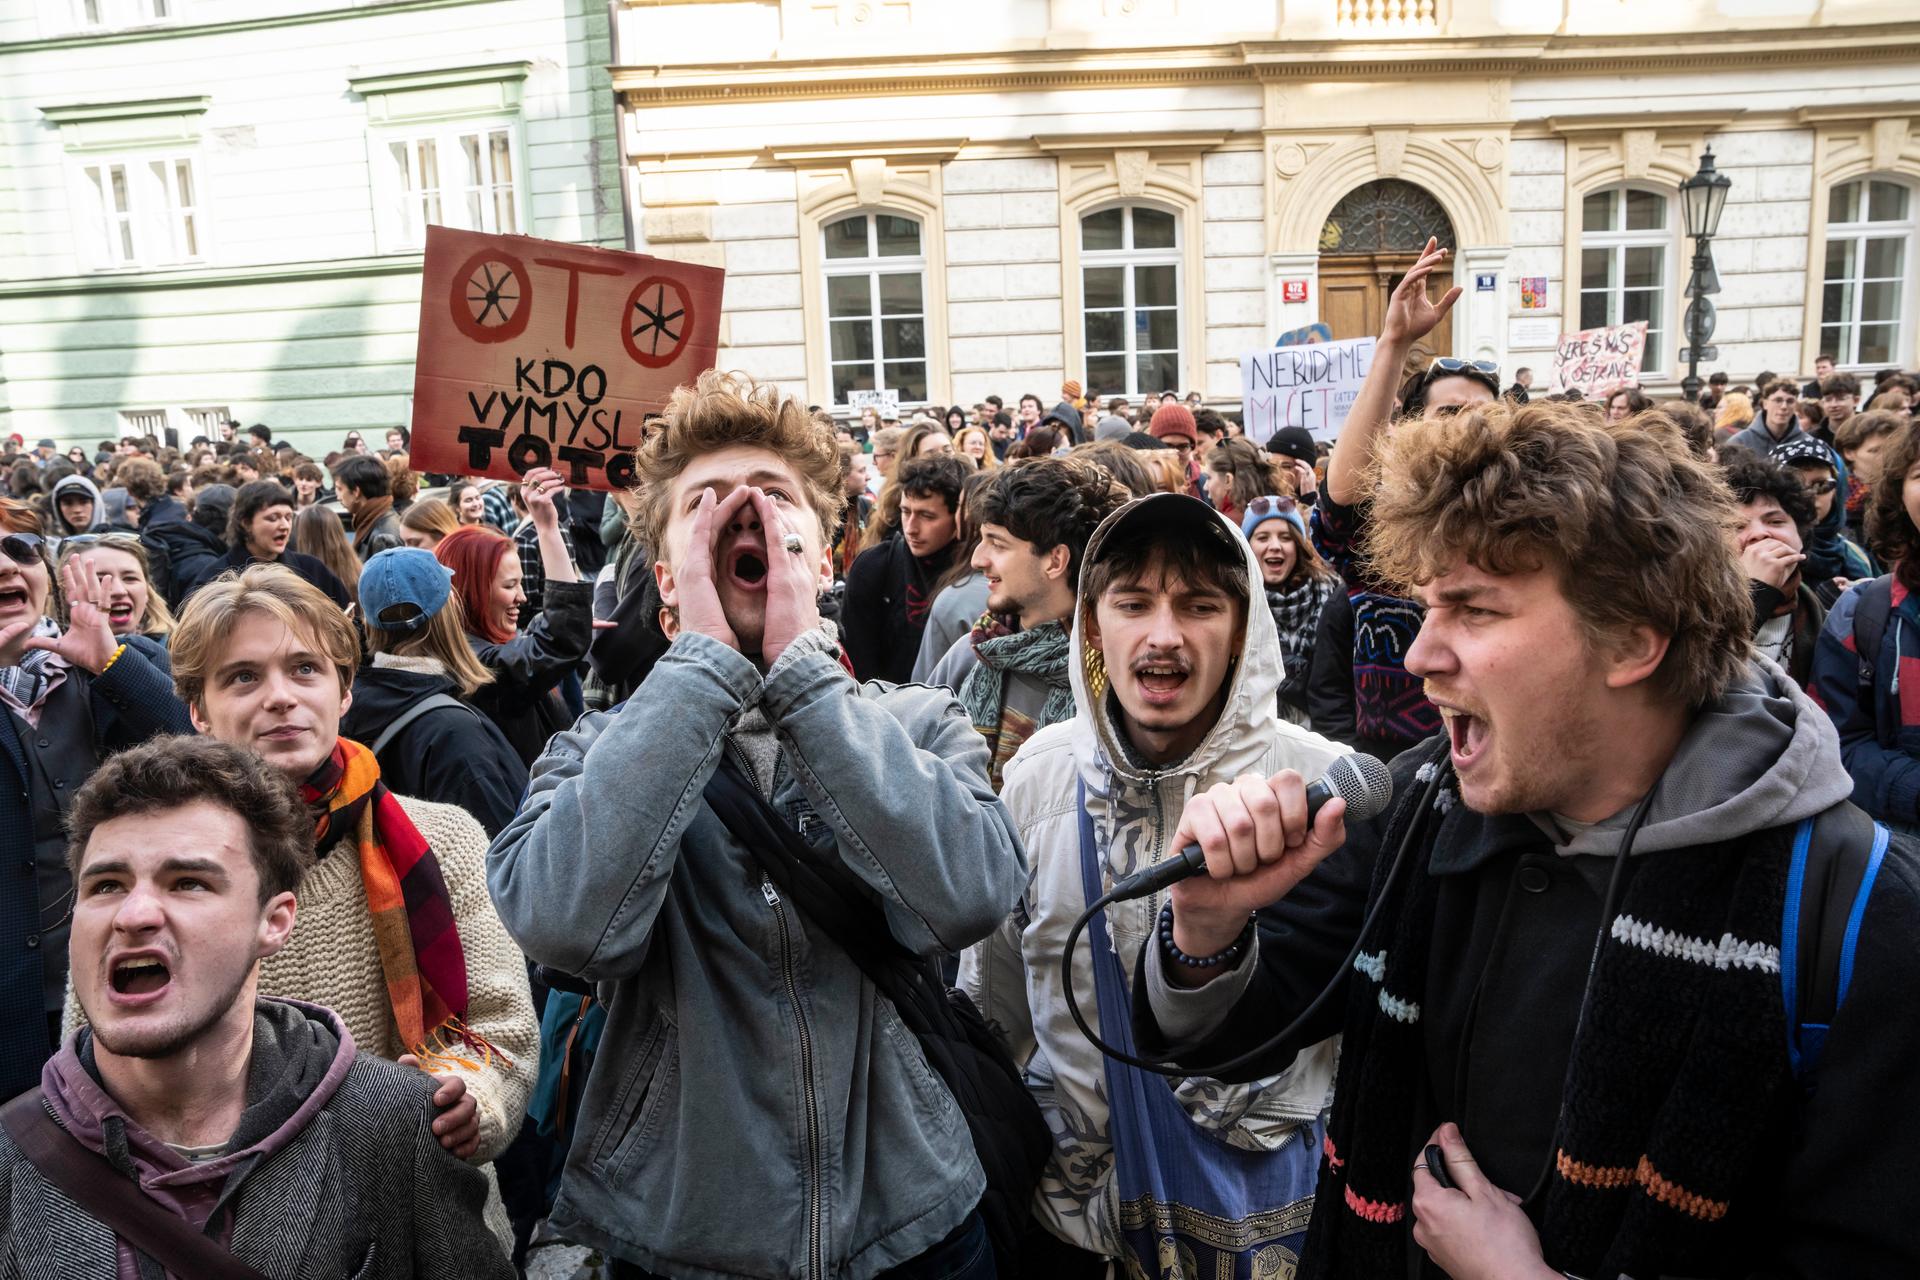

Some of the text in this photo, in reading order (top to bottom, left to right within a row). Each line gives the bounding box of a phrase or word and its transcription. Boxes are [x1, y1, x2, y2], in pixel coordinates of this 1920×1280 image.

[450, 248, 695, 369] OTO
[516, 357, 607, 405] KDO
[1252, 343, 1370, 390] NEBUDEME
[458, 425, 638, 489] TOTO
